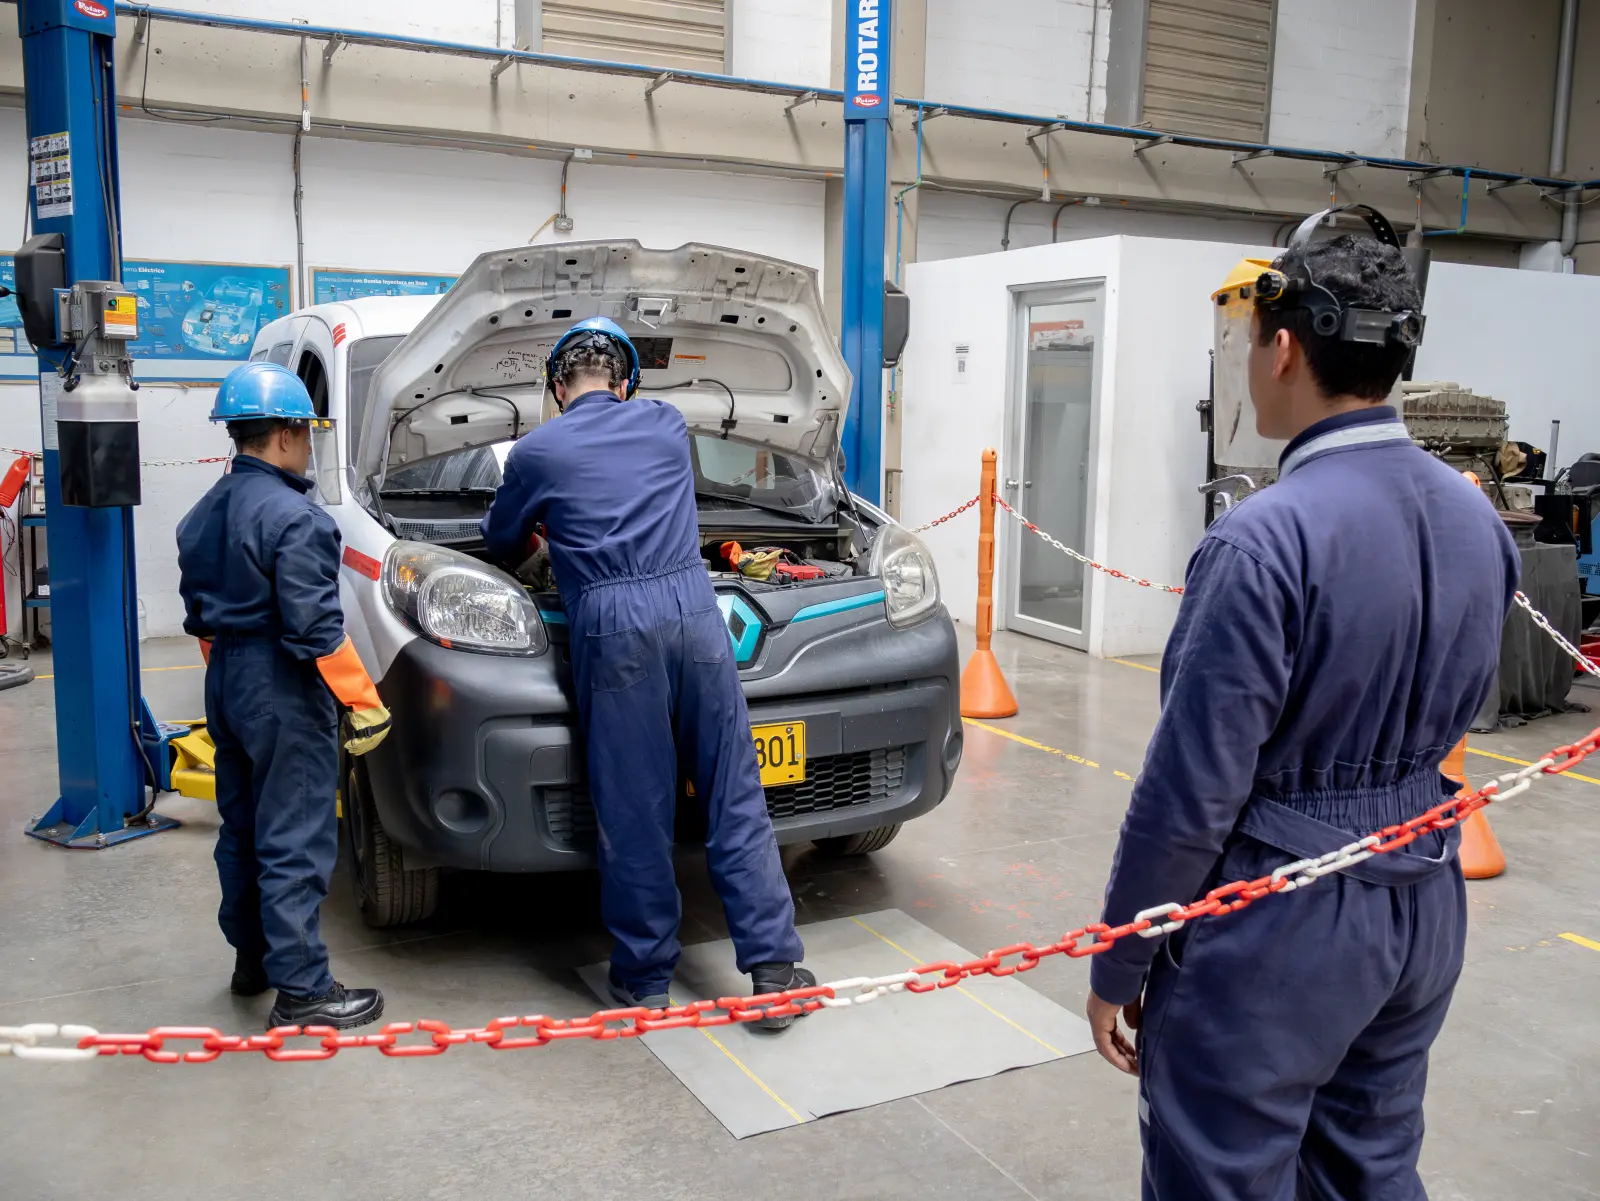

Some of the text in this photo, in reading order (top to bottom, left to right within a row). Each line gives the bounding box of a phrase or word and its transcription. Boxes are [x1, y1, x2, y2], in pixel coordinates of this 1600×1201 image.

[76, 0, 106, 17] Rotary
[855, 96, 880, 106] Rotary
[754, 734, 799, 769] 801
